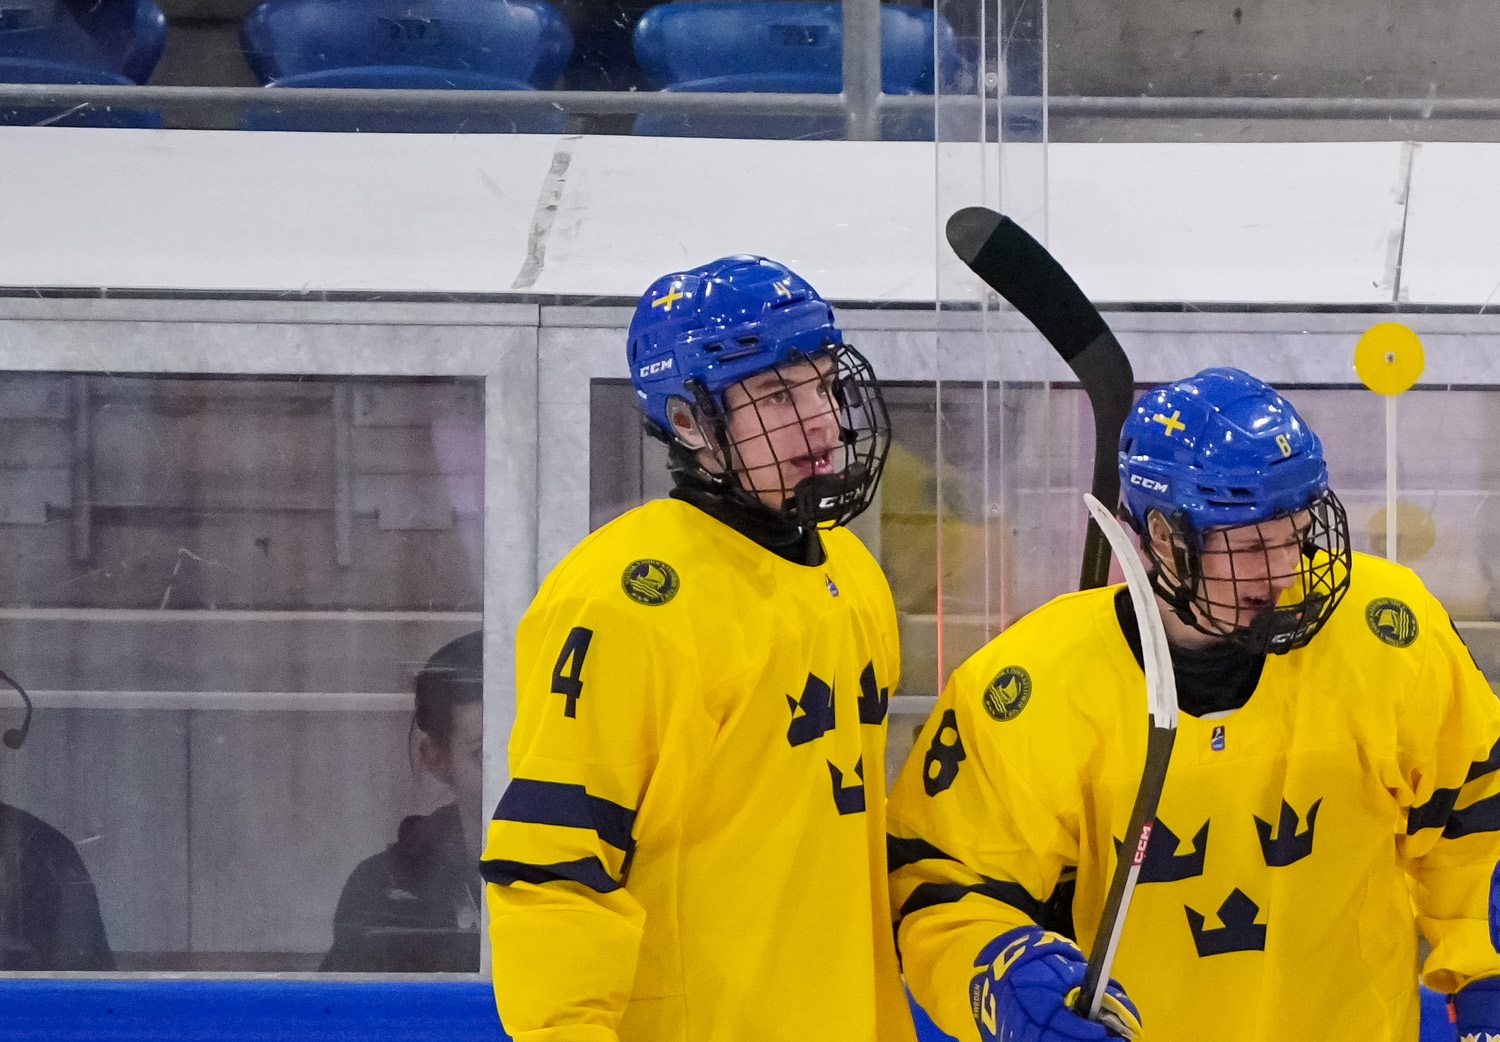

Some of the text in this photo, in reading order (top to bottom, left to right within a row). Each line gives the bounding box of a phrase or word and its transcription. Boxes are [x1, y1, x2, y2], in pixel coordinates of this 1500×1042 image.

[640, 357, 674, 379] CCM
[1275, 433, 1292, 458] 8
[1130, 474, 1168, 493] CCM
[550, 626, 594, 720] 4
[923, 708, 968, 799] 8
[1133, 822, 1153, 866] CCM
